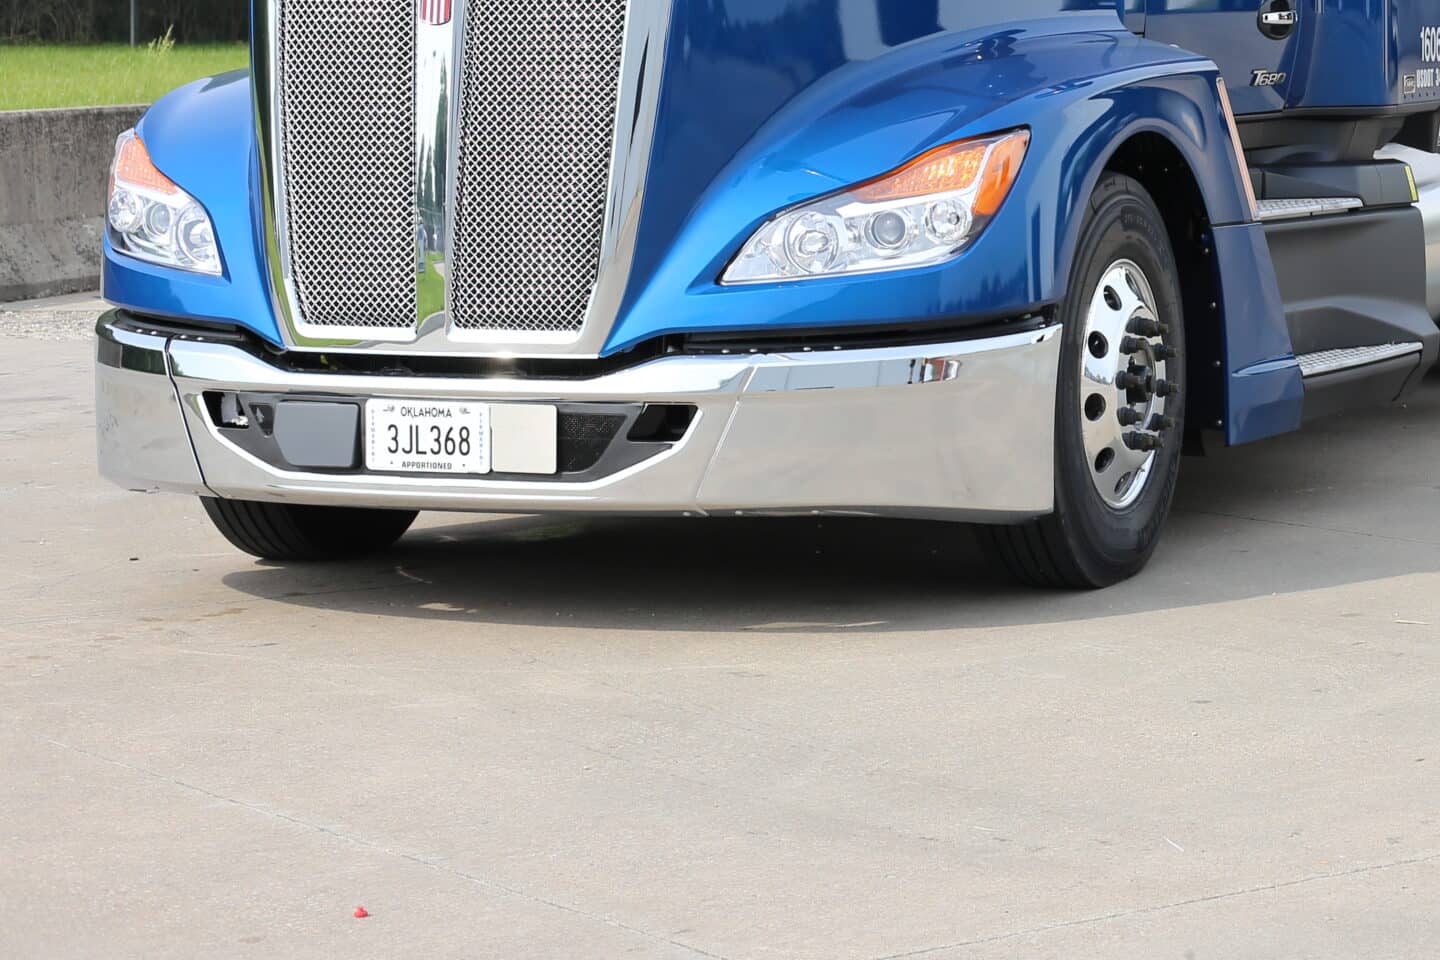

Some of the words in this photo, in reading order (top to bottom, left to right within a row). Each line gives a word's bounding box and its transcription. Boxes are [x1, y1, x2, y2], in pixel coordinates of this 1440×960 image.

[1250, 69, 1287, 87] T680
[1416, 68, 1434, 89] USDOT
[400, 406, 453, 419] OKLAHOMA
[387, 424, 471, 456] 3JL368
[401, 461, 453, 470] APPORTIONED
